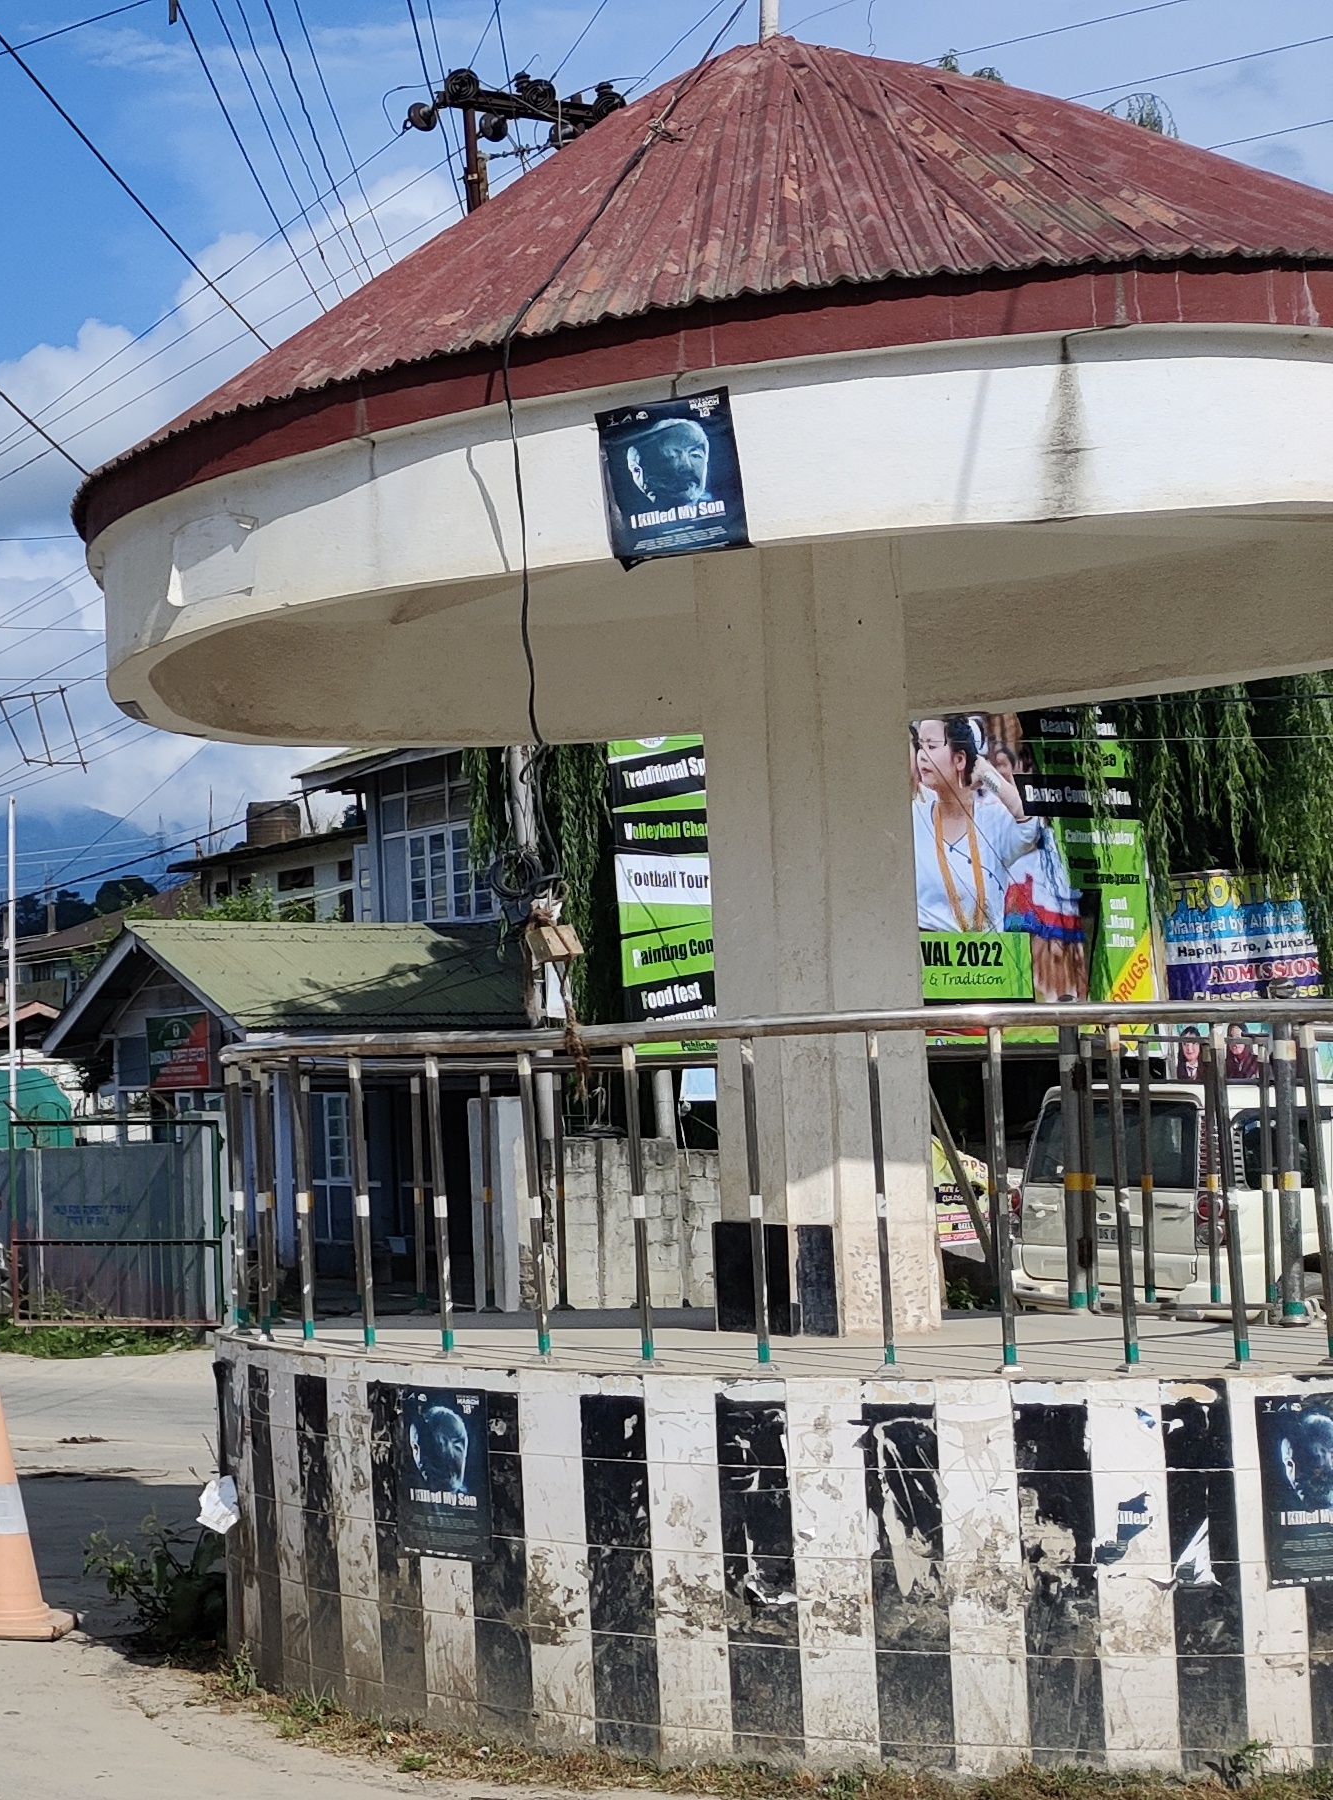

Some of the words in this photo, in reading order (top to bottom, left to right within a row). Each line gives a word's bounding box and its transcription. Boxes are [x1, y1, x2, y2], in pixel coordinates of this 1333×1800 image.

[631, 514, 637, 529] I
[638, 508, 676, 528] Killed
[678, 505, 697, 520] My
[698, 500, 726, 516] Son
[622, 758, 689, 789] Traditional
[1024, 784, 1063, 803] Dance
[624, 821, 681, 840] Volleyball
[627, 867, 677, 889] Football
[1109, 897, 1128, 911] and
[1169, 915, 1226, 935] Managed
[632, 942, 687, 968] Painting
[955, 941, 1004, 967] 2022
[1230, 941, 1261, 954] Ziro,
[929, 973, 938, 986] &
[941, 972, 1007, 986] Tradition
[1207, 956, 1323, 986] ADMISSION
[641, 985, 674, 1010] Food
[674, 981, 703, 1004] fest
[410, 1488, 415, 1501] I
[415, 1489, 443, 1504] Killed
[443, 1491, 457, 1507] My
[457, 1493, 478, 1508] Son
[1280, 1511, 1286, 1526] I
[1287, 1510, 1320, 1526] Killed
